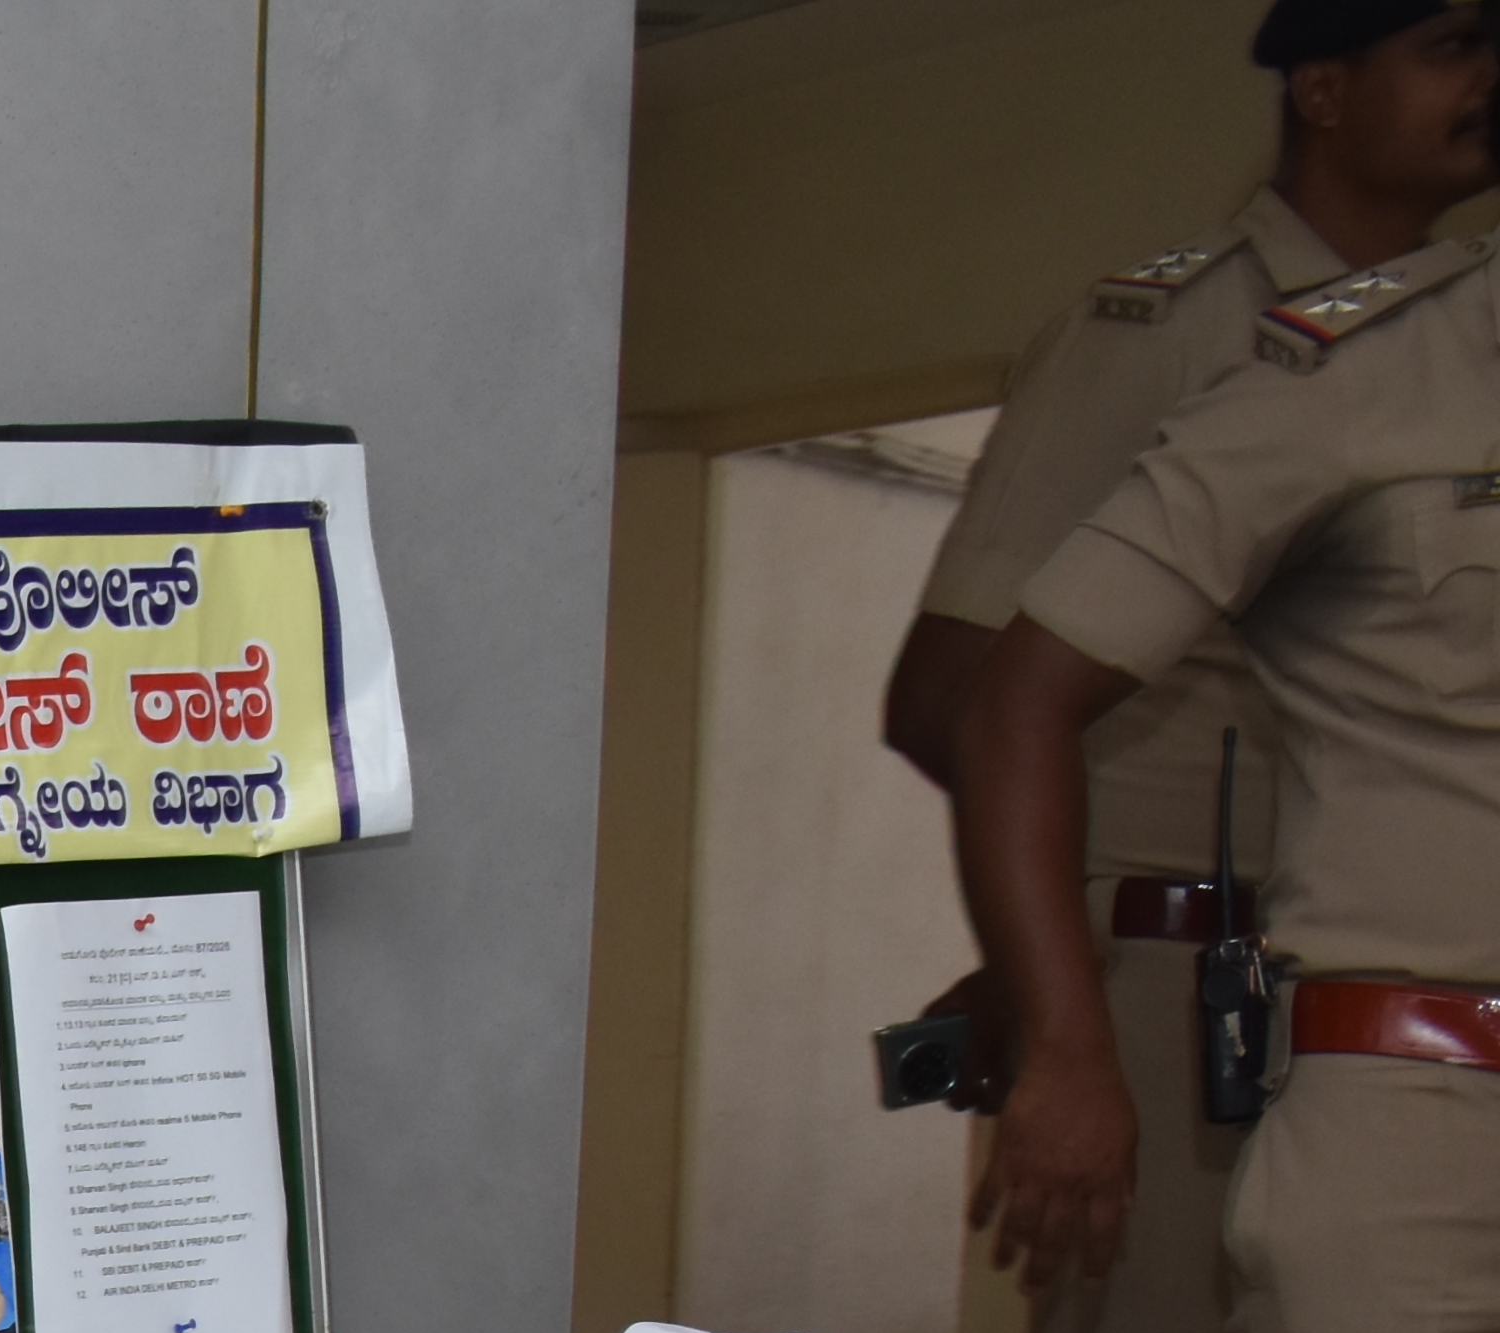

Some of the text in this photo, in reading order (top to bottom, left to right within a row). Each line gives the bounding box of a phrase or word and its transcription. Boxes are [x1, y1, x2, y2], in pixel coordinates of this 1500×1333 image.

[130, 644, 274, 744] ಠಾಣೆ
[152, 755, 287, 835] ವಿಭಾಗ
[70, 1103, 93, 1111] Phone
[133, 1243, 151, 1252] Bank
[152, 1240, 176, 1250] DEBIT
[186, 1235, 224, 1246] PREPAID
[166, 1279, 197, 1290] METRO
